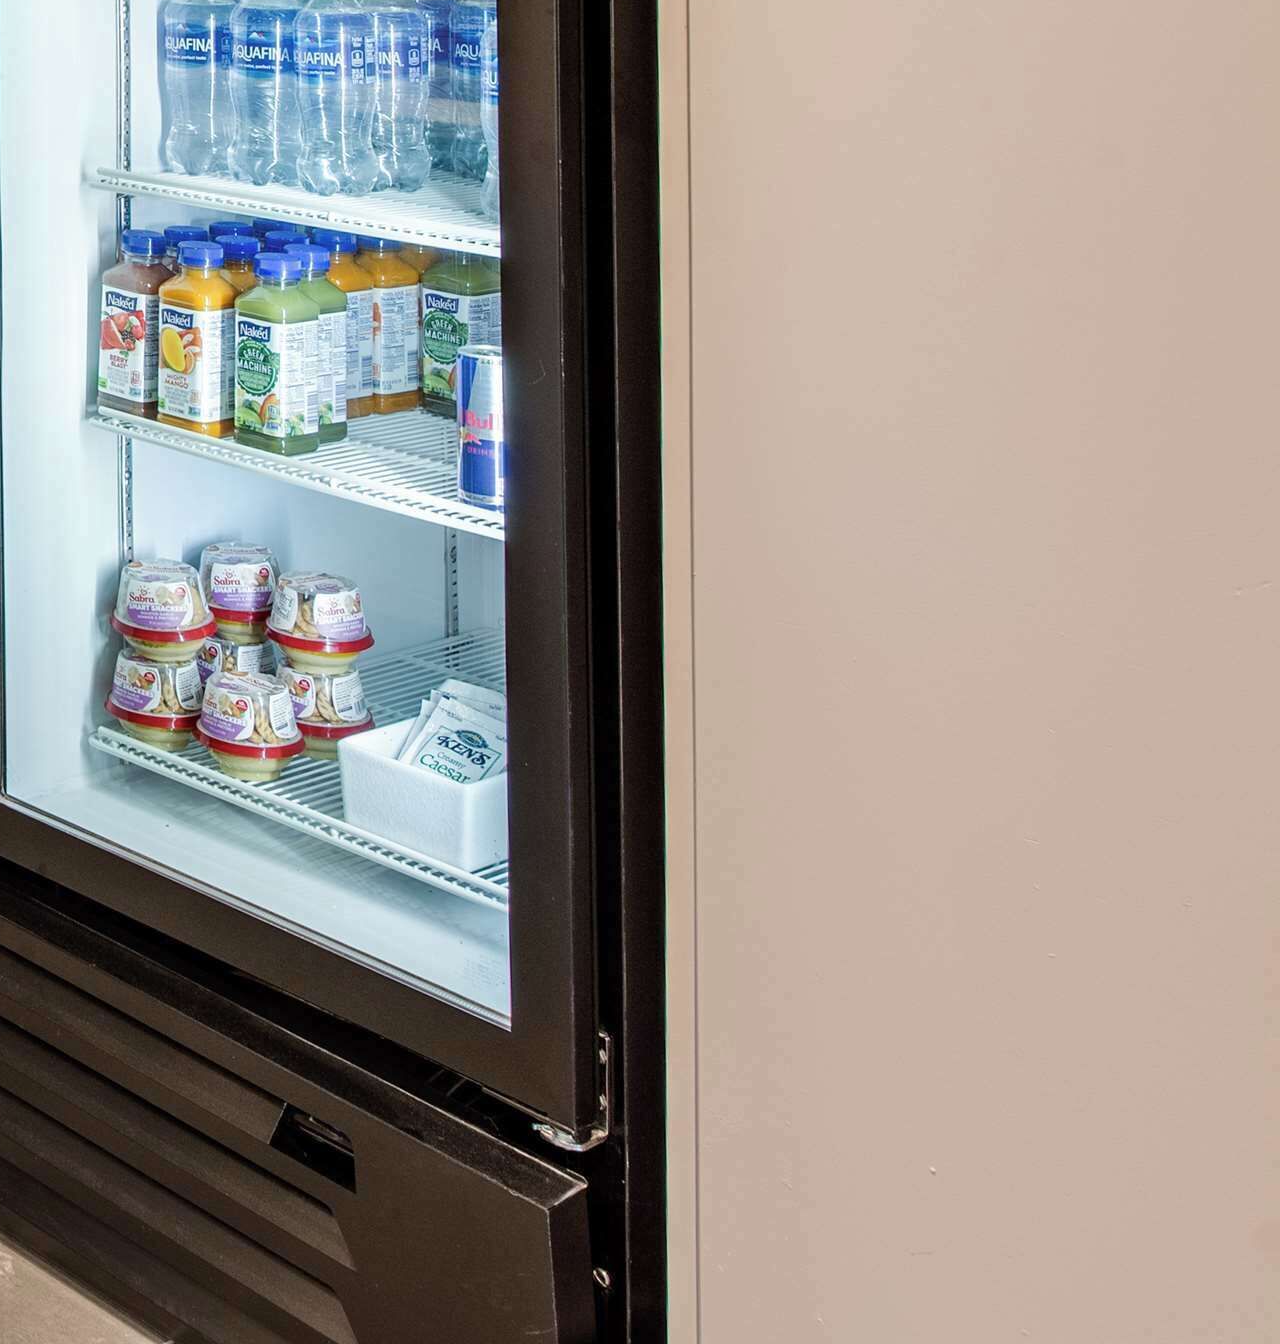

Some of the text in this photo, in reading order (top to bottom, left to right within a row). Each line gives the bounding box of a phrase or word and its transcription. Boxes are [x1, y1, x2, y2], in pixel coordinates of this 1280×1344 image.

[431, 319, 453, 332] GREEN
[425, 329, 461, 345] MACHINE
[243, 348, 265, 362] GREEN
[214, 575, 241, 586] Sabra
[129, 593, 155, 604] Sabra
[317, 606, 346, 617] Sabra
[437, 736, 491, 766] KEN'S
[420, 753, 471, 784] Caesar
